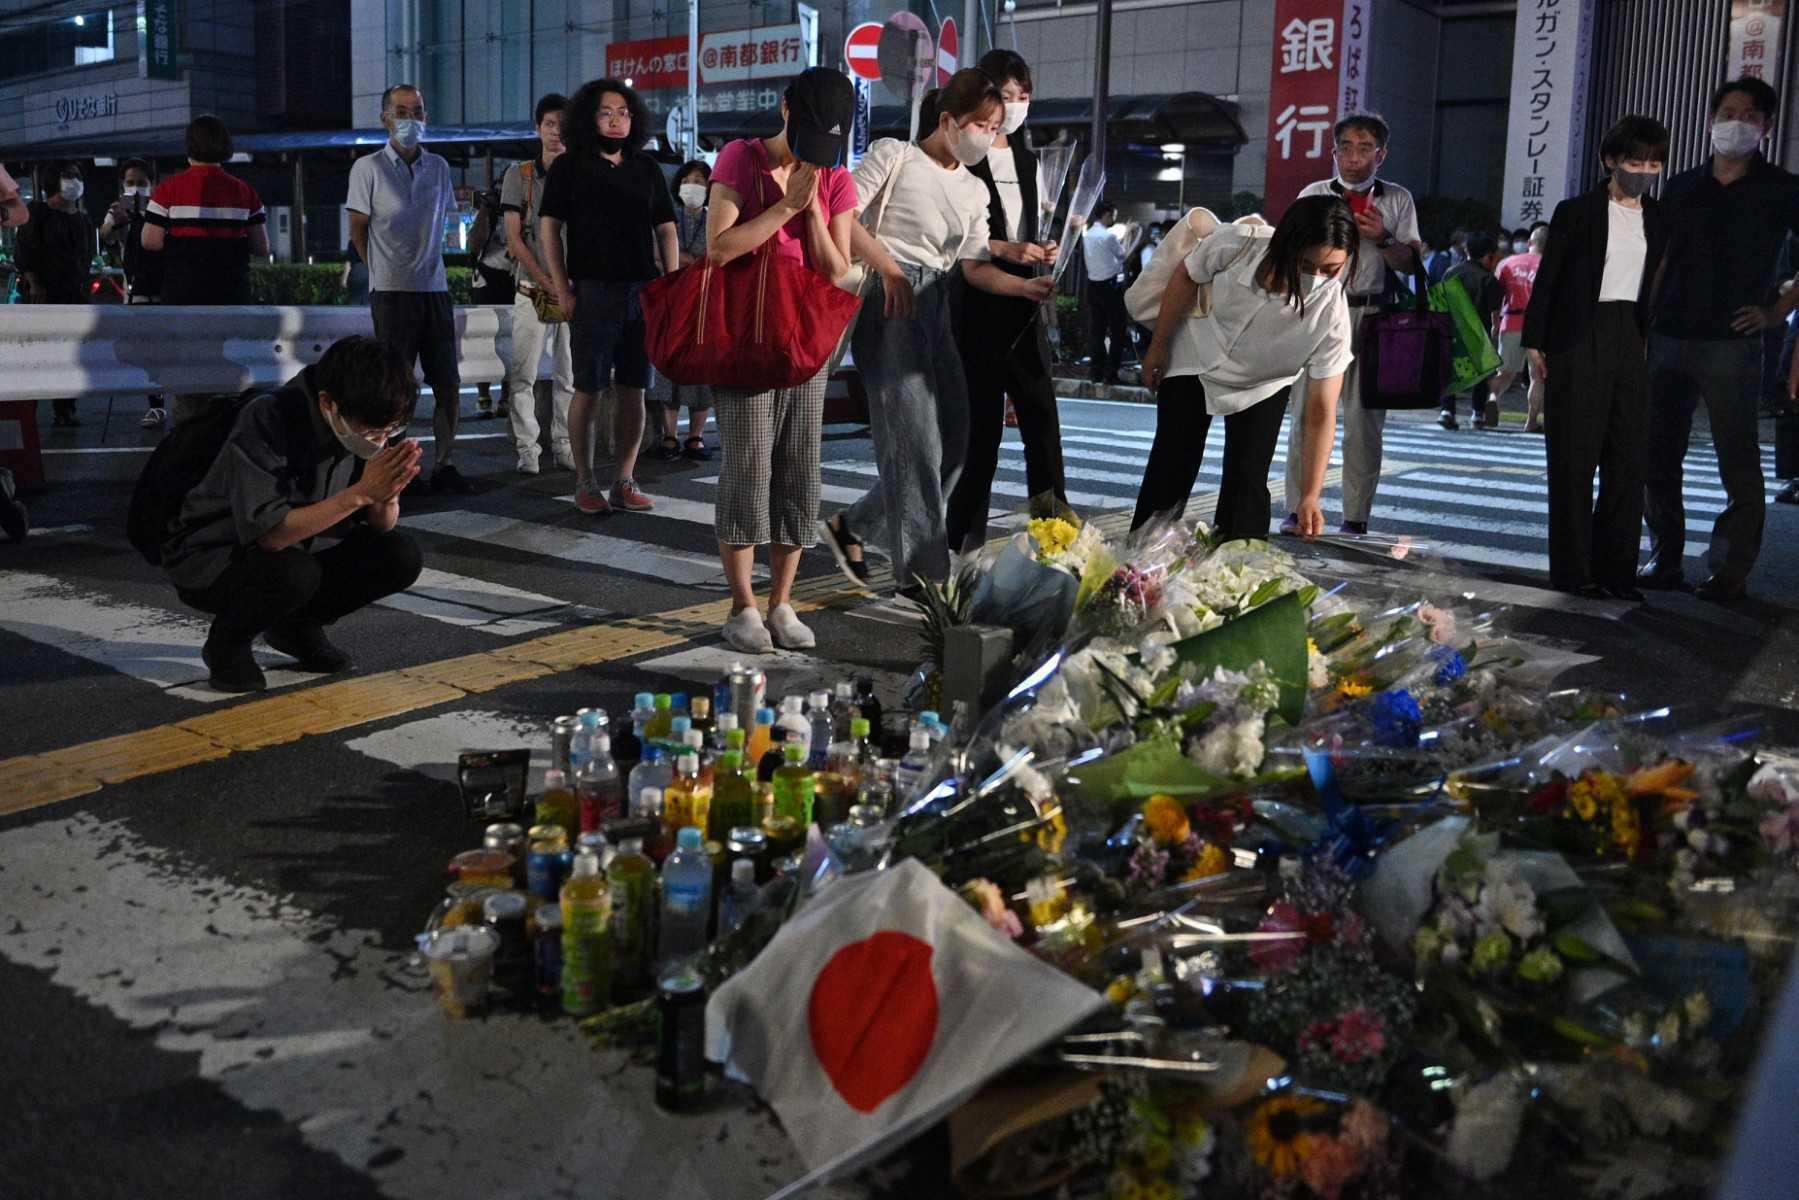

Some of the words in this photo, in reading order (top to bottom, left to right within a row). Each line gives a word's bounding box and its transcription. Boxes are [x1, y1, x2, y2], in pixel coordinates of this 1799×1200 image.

[609, 51, 689, 78] ほけんの窓口
[703, 37, 800, 69] @南都銀行
[1275, 17, 1335, 160] 銀行
